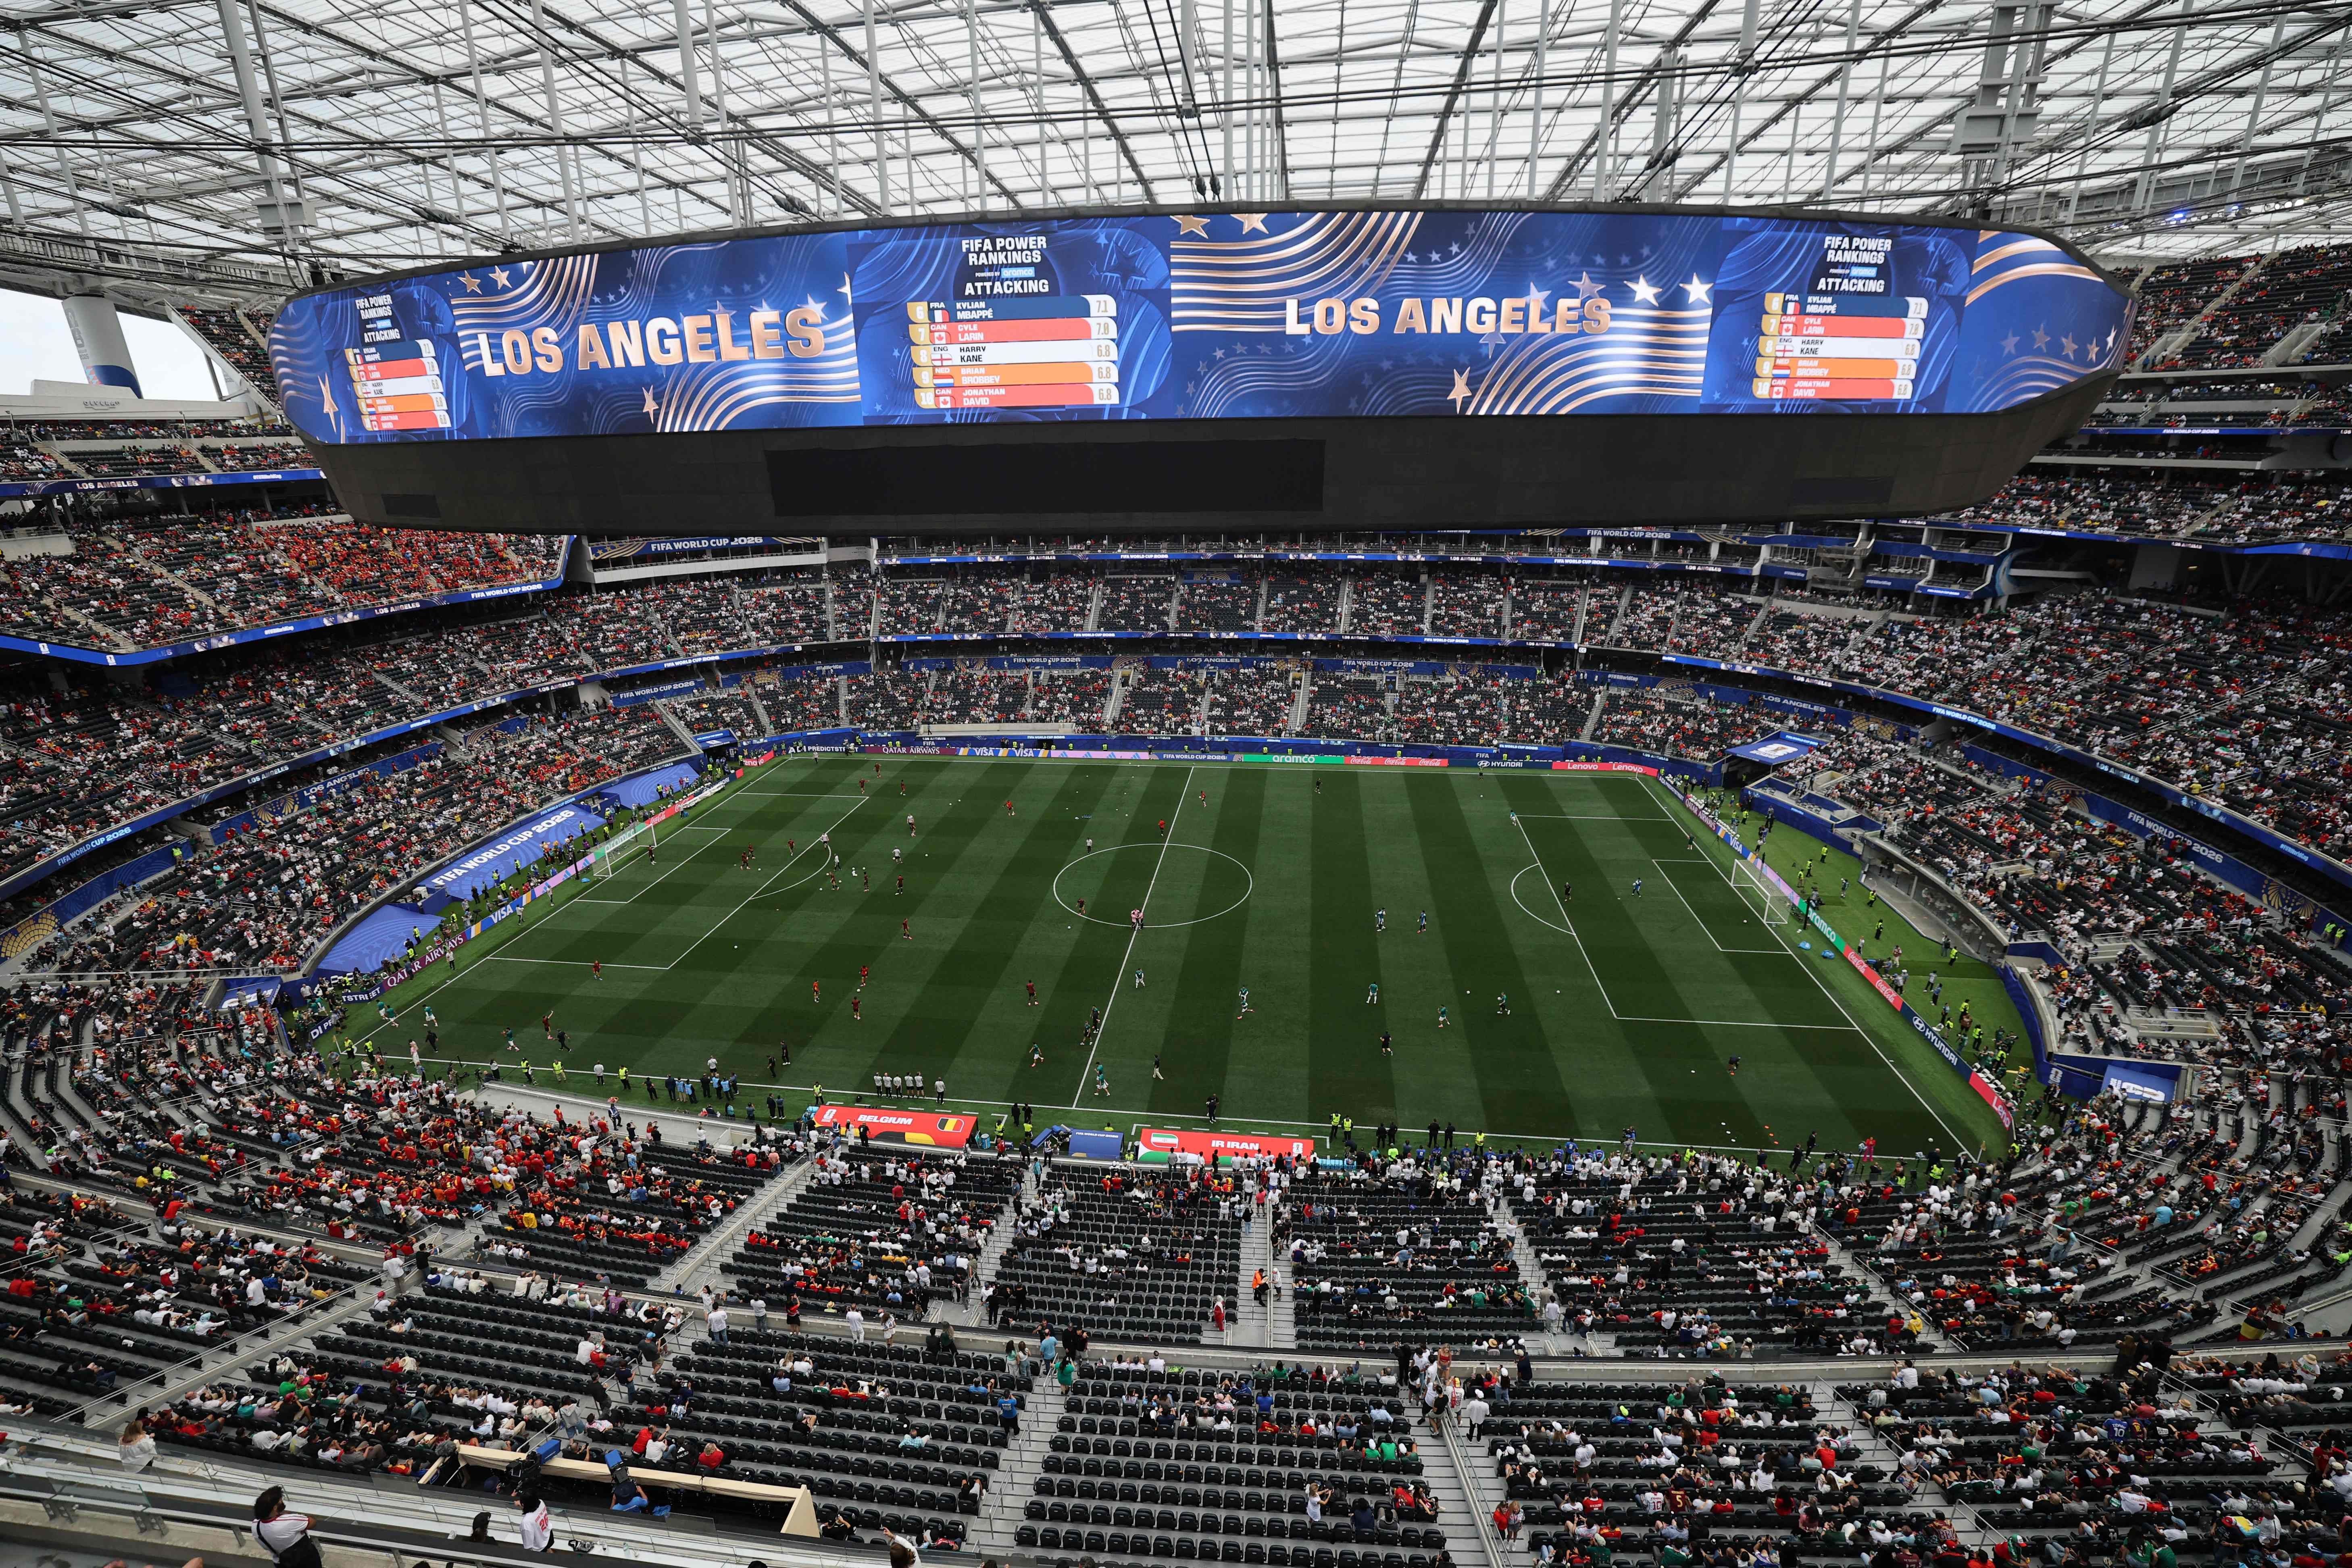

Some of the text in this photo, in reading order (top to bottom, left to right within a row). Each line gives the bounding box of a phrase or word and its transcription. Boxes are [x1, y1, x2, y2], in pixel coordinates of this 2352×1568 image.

[962, 236, 1047, 252] FIFA POWER
[1824, 236, 1892, 251] FIFA POWER
[968, 250, 1042, 265] RANKINGS
[1827, 249, 1885, 264] RANKINGS
[965, 279, 1049, 296] ATTACKING
[1817, 277, 1885, 292] ATTACKING
[355, 294, 393, 310] FIFA POWER
[1096, 300, 1108, 313] 7.1
[360, 306, 392, 319] RANKINGS
[916, 306, 924, 319] 6
[957, 308, 993, 319] MBAPPÉ
[1285, 297, 1611, 335] LOS ANGELES
[364, 328, 401, 343] ATTACKING
[918, 328, 925, 341] 7
[1096, 323, 1109, 335] 7.0
[477, 308, 825, 377] LOS ANGELES
[958, 332, 984, 341] LARIN
[920, 350, 927, 363] 8
[1097, 345, 1110, 357] 6.8
[921, 371, 929, 384] 9
[1098, 367, 1111, 379] 6.8
[920, 392, 934, 405] 10
[1098, 388, 1112, 400] 6.8
[1793, 389, 1815, 397] DAVID
[963, 397, 990, 406] DAVID
[97, 481, 138, 489] ANGELES
[651, 537, 763, 552] FIFA WORLD CUP 2026
[486, 588, 508, 597] WORLD
[390, 602, 420, 612] ANGELES
[550, 681, 575, 690] ANGELES
[634, 687, 658, 696] WORLD
[673, 681, 695, 689] 2026
[1805, 678, 1832, 687] ANGELES
[1782, 699, 1826, 712] ANGELES
[1946, 710, 1967, 720] WORLD
[1612, 763, 1643, 772] Lenovo
[247, 765, 289, 784] LOS ANGELES
[303, 767, 369, 796] LOS ANGELES
[1685, 799, 1716, 831] QATAR AIRWAYS
[2128, 812, 2146, 826] FIFA
[2146, 819, 2175, 839] WORLD
[2192, 843, 2223, 863] 2026
[57, 827, 132, 866] FIFA WORLD CUP 2026
[431, 866, 469, 885] FIFA
[464, 844, 511, 869] WORLD
[507, 831, 533, 845] CUP
[531, 810, 575, 833] 2026
[1730, 835, 1742, 854] VISA
[491, 904, 514, 924] VISA
[1808, 906, 1836, 942] aramco
[1925, 1028, 1958, 1066] HYUNDAI
[857, 1114, 913, 1125] BELGIUM
[1211, 1140, 1259, 1150] IR IRAN
[2114, 1427, 2125, 1437] 10
[1652, 1501, 1661, 1510] 10
[1677, 1495, 1683, 1508] 5
